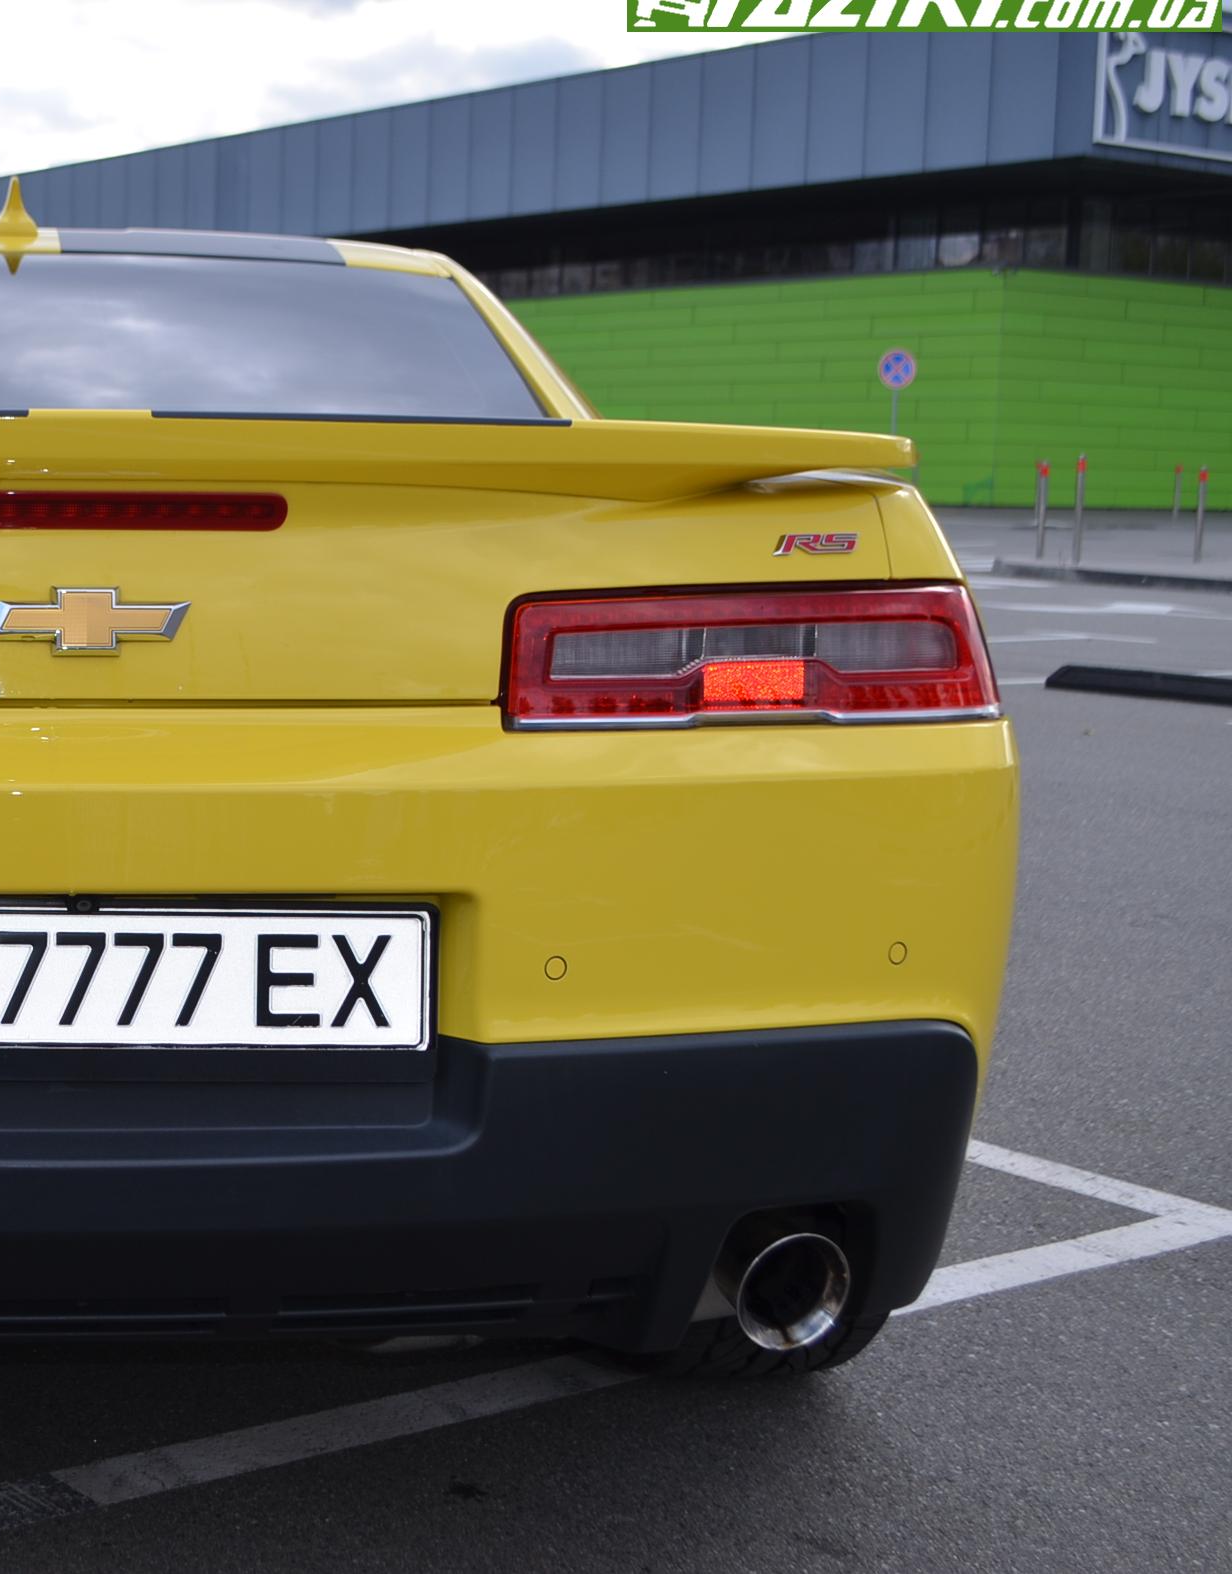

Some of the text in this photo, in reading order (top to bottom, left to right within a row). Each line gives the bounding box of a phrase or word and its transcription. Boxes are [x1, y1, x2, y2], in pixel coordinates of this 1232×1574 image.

[1132, 49, 1232, 124] JYS
[773, 532, 859, 556] RS
[255, 933, 393, 1028] EX
